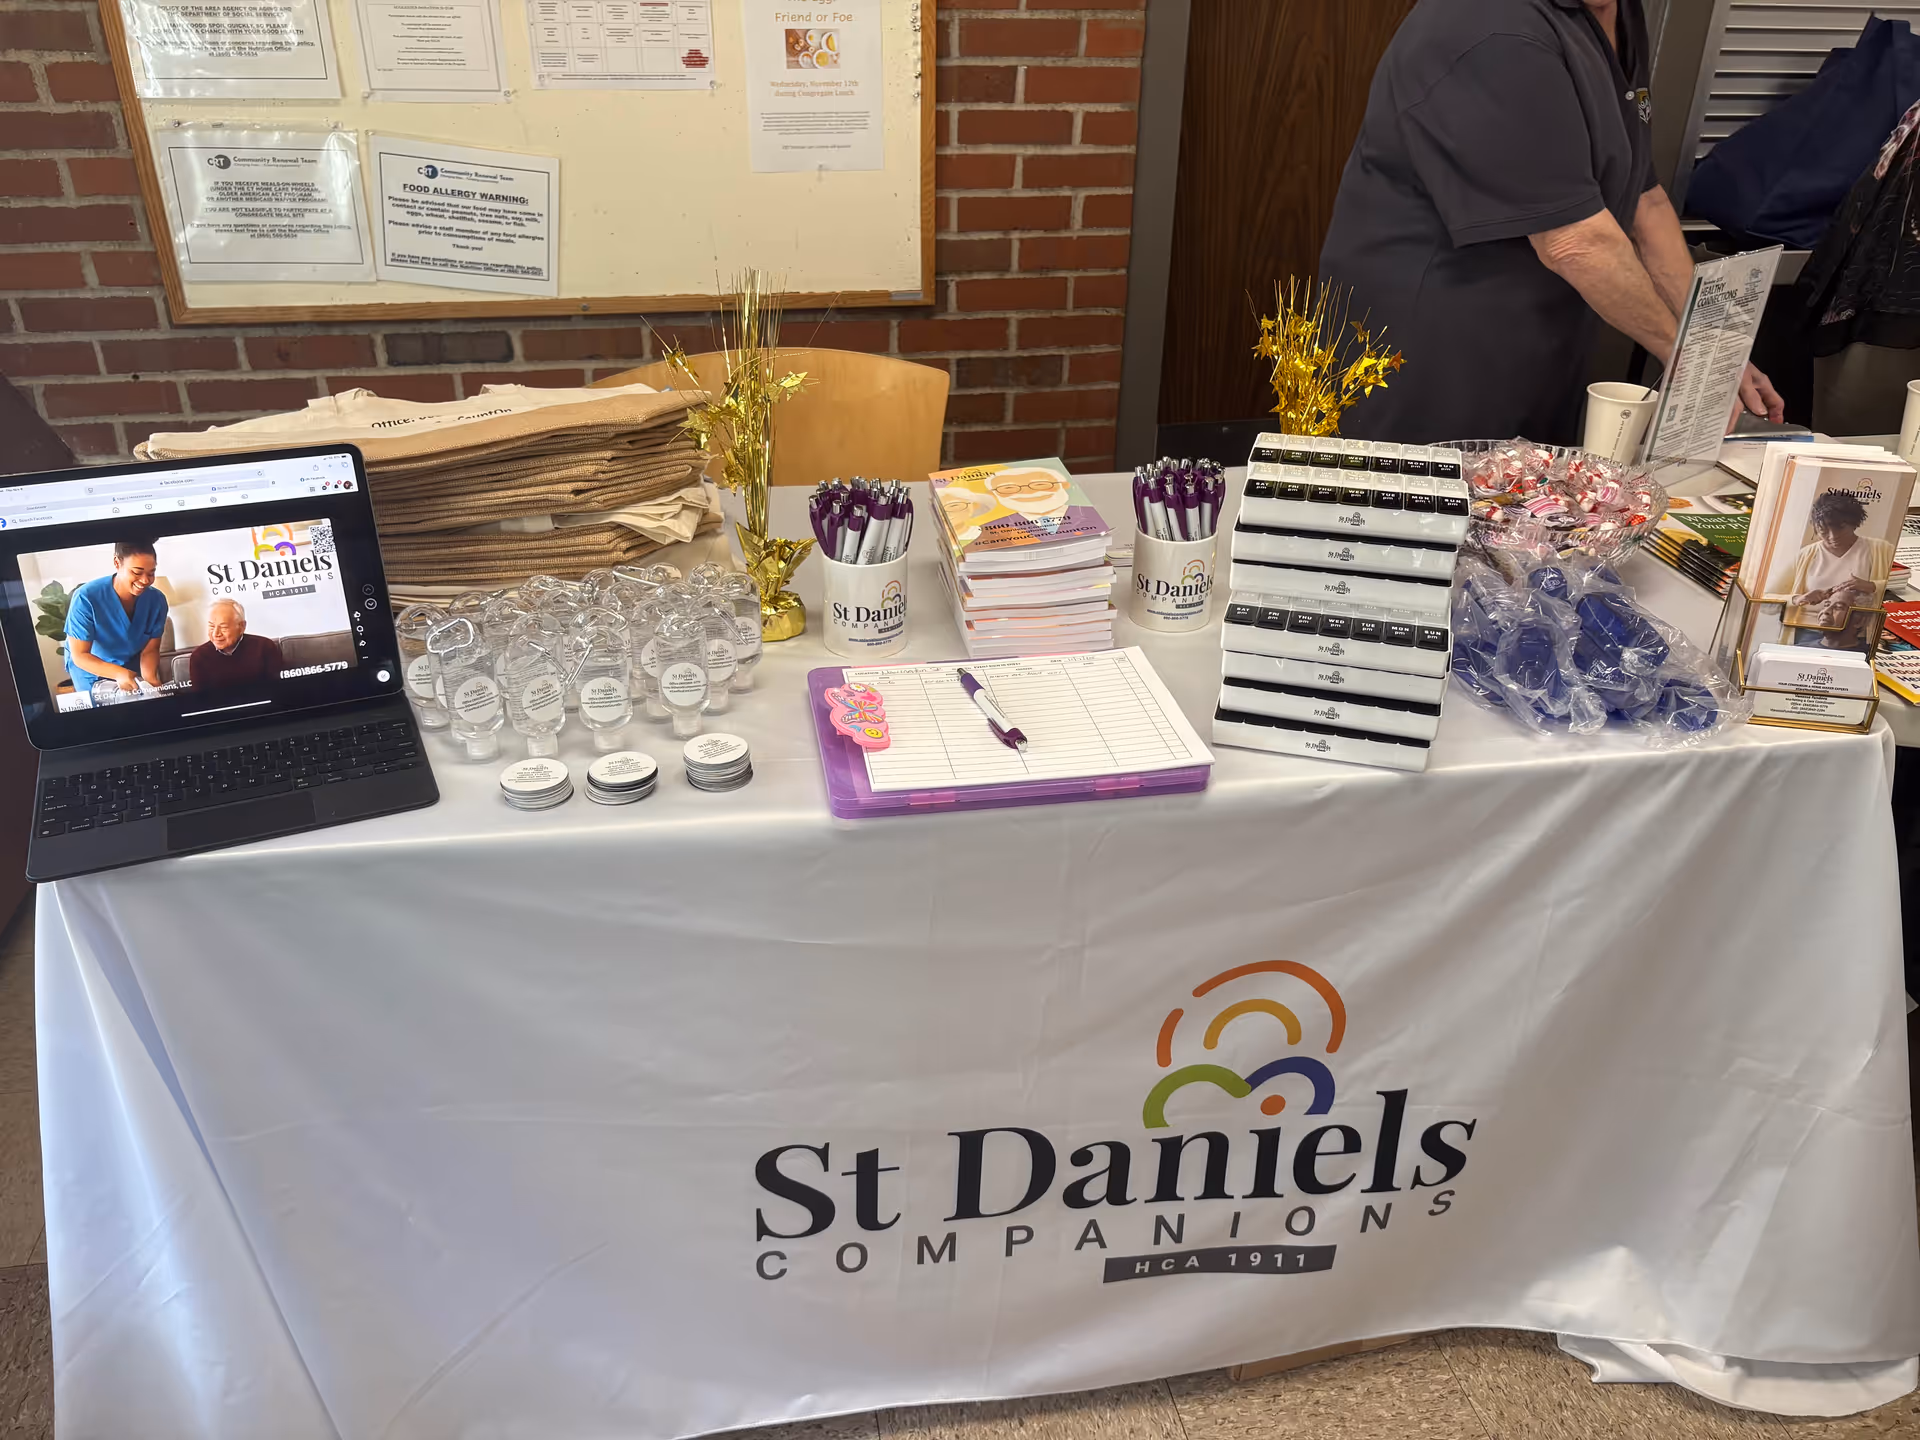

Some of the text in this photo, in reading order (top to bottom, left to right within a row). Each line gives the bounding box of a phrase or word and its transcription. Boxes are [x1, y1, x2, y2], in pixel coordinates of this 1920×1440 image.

[775, 12, 852, 22] Friend or Foe
[440, 168, 472, 177] Community
[403, 184, 529, 204] FOOD ALLERGY WARNING:
[1698, 289, 1738, 308] CONNECTIONS
[1700, 282, 1726, 296] HEALTHY
[1828, 486, 1882, 499] St Daniels
[1680, 515, 1736, 523] What's
[1691, 522, 1728, 530] Your
[207, 550, 332, 585] St Daniels
[212, 572, 334, 596] COMPANIONS
[1137, 573, 1214, 598] St Daniels
[834, 595, 906, 622] St Daniel
[280, 660, 348, 679] (860)866-5779
[1806, 674, 1833, 682] Daniels
[132, 683, 179, 696] Companions,
[180, 680, 192, 688] LLC
[754, 1088, 1478, 1243] St Daniels
[755, 1190, 1456, 1281] COMPANIONS
[1135, 1251, 1307, 1276] HCA 1911
